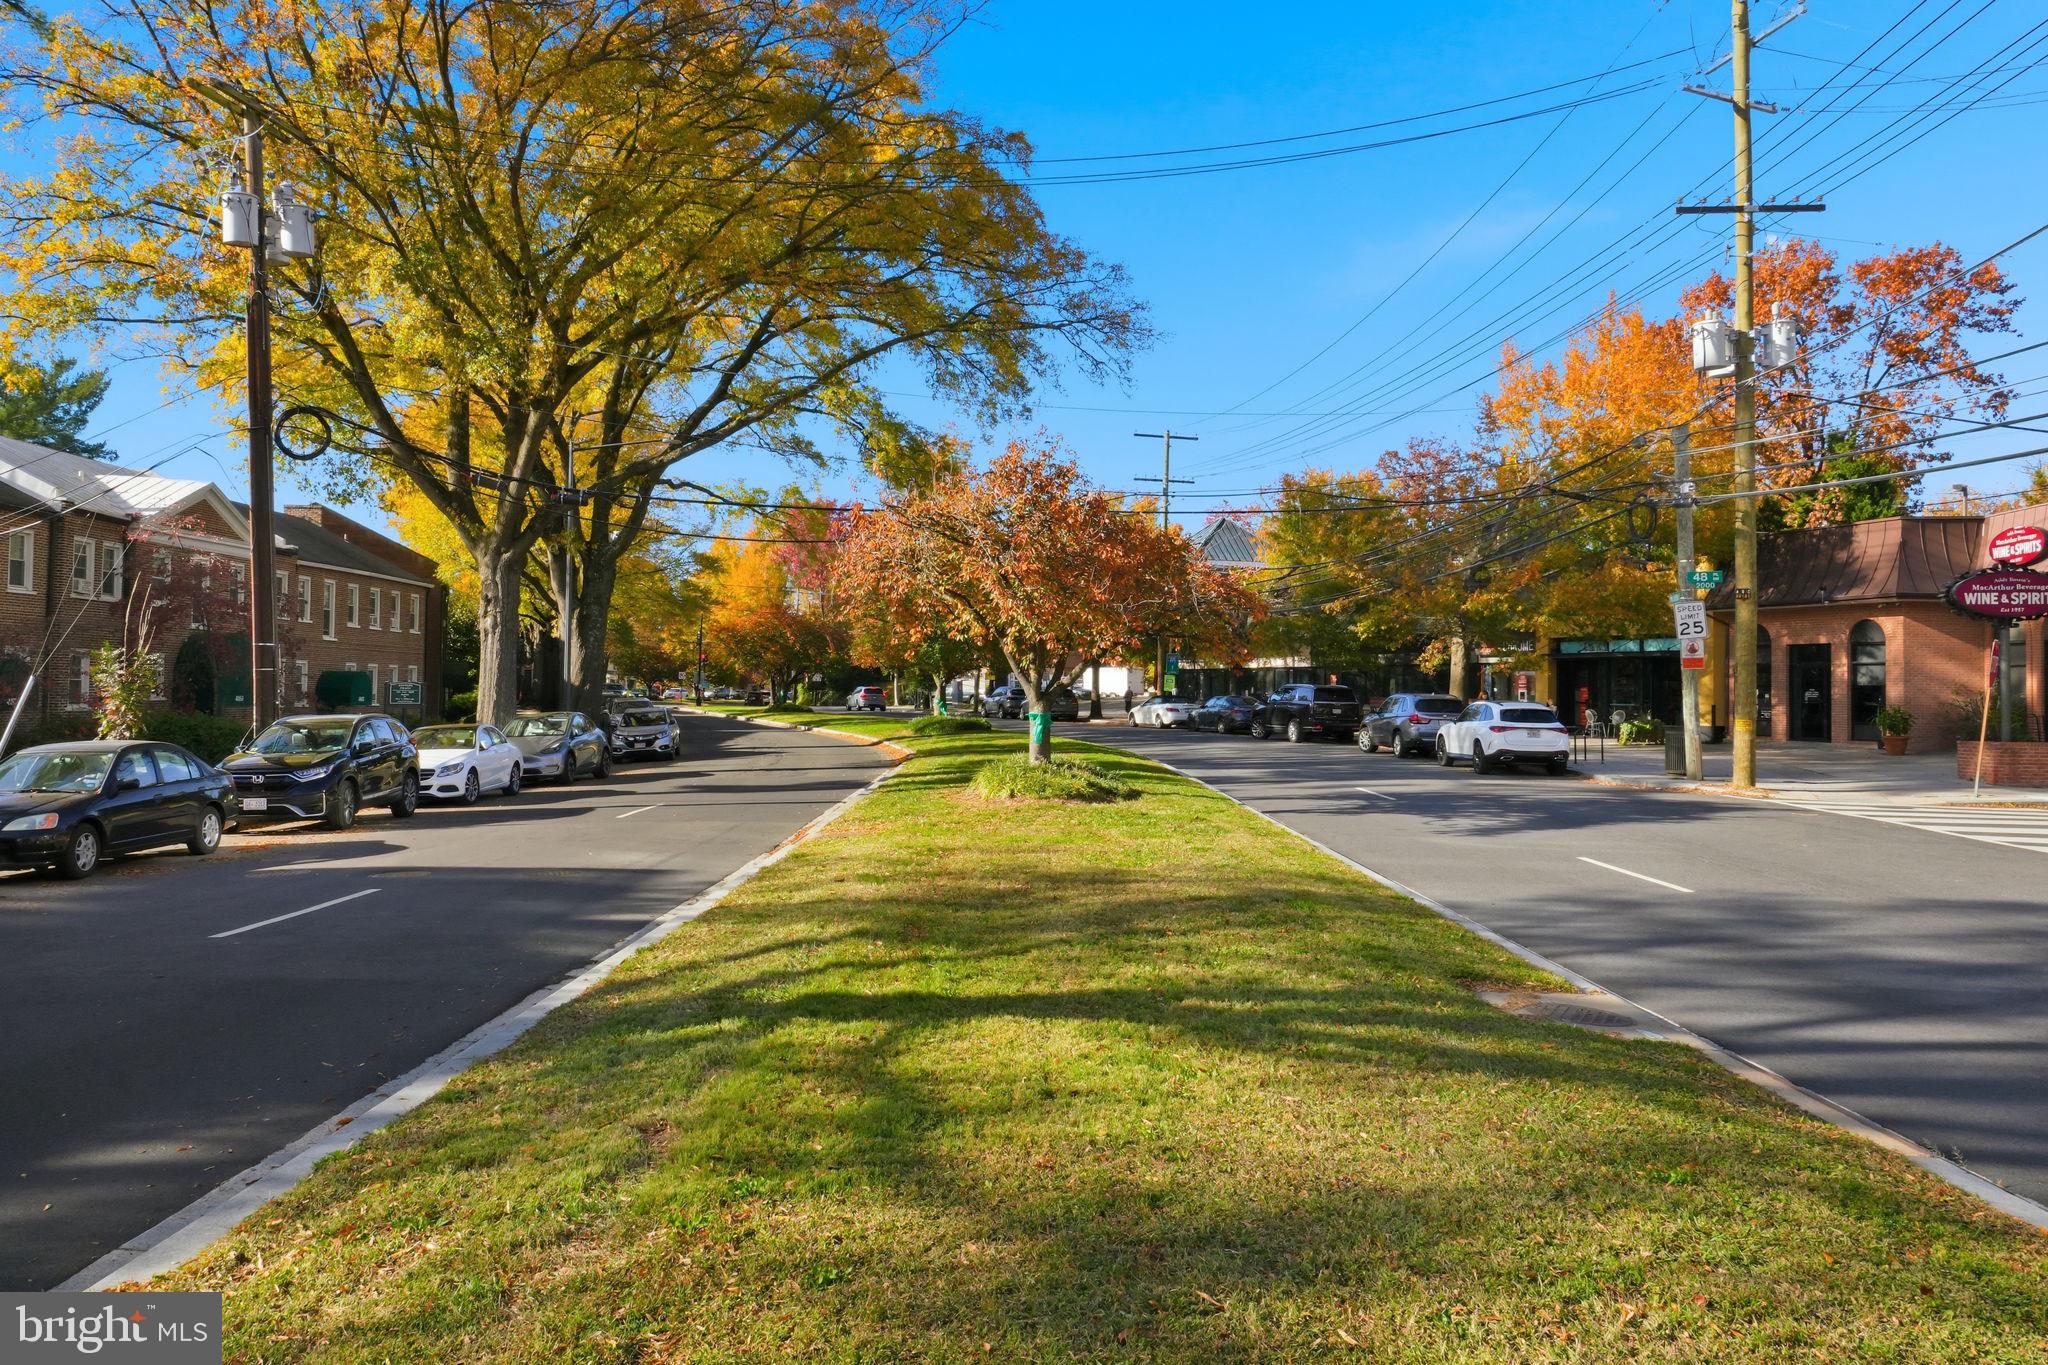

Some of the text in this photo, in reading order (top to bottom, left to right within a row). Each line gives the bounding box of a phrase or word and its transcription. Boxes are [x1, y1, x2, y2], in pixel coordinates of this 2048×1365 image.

[1992, 545, 2010, 559] WINE
[2015, 539, 2042, 556] SPIRITS
[1693, 573, 1708, 581] 48
[1963, 592, 1999, 605] WINE
[2001, 594, 2009, 603] &
[1677, 604, 1702, 613] SPEED
[1681, 612, 1700, 620] LIMIT
[1680, 621, 1704, 635] 25
